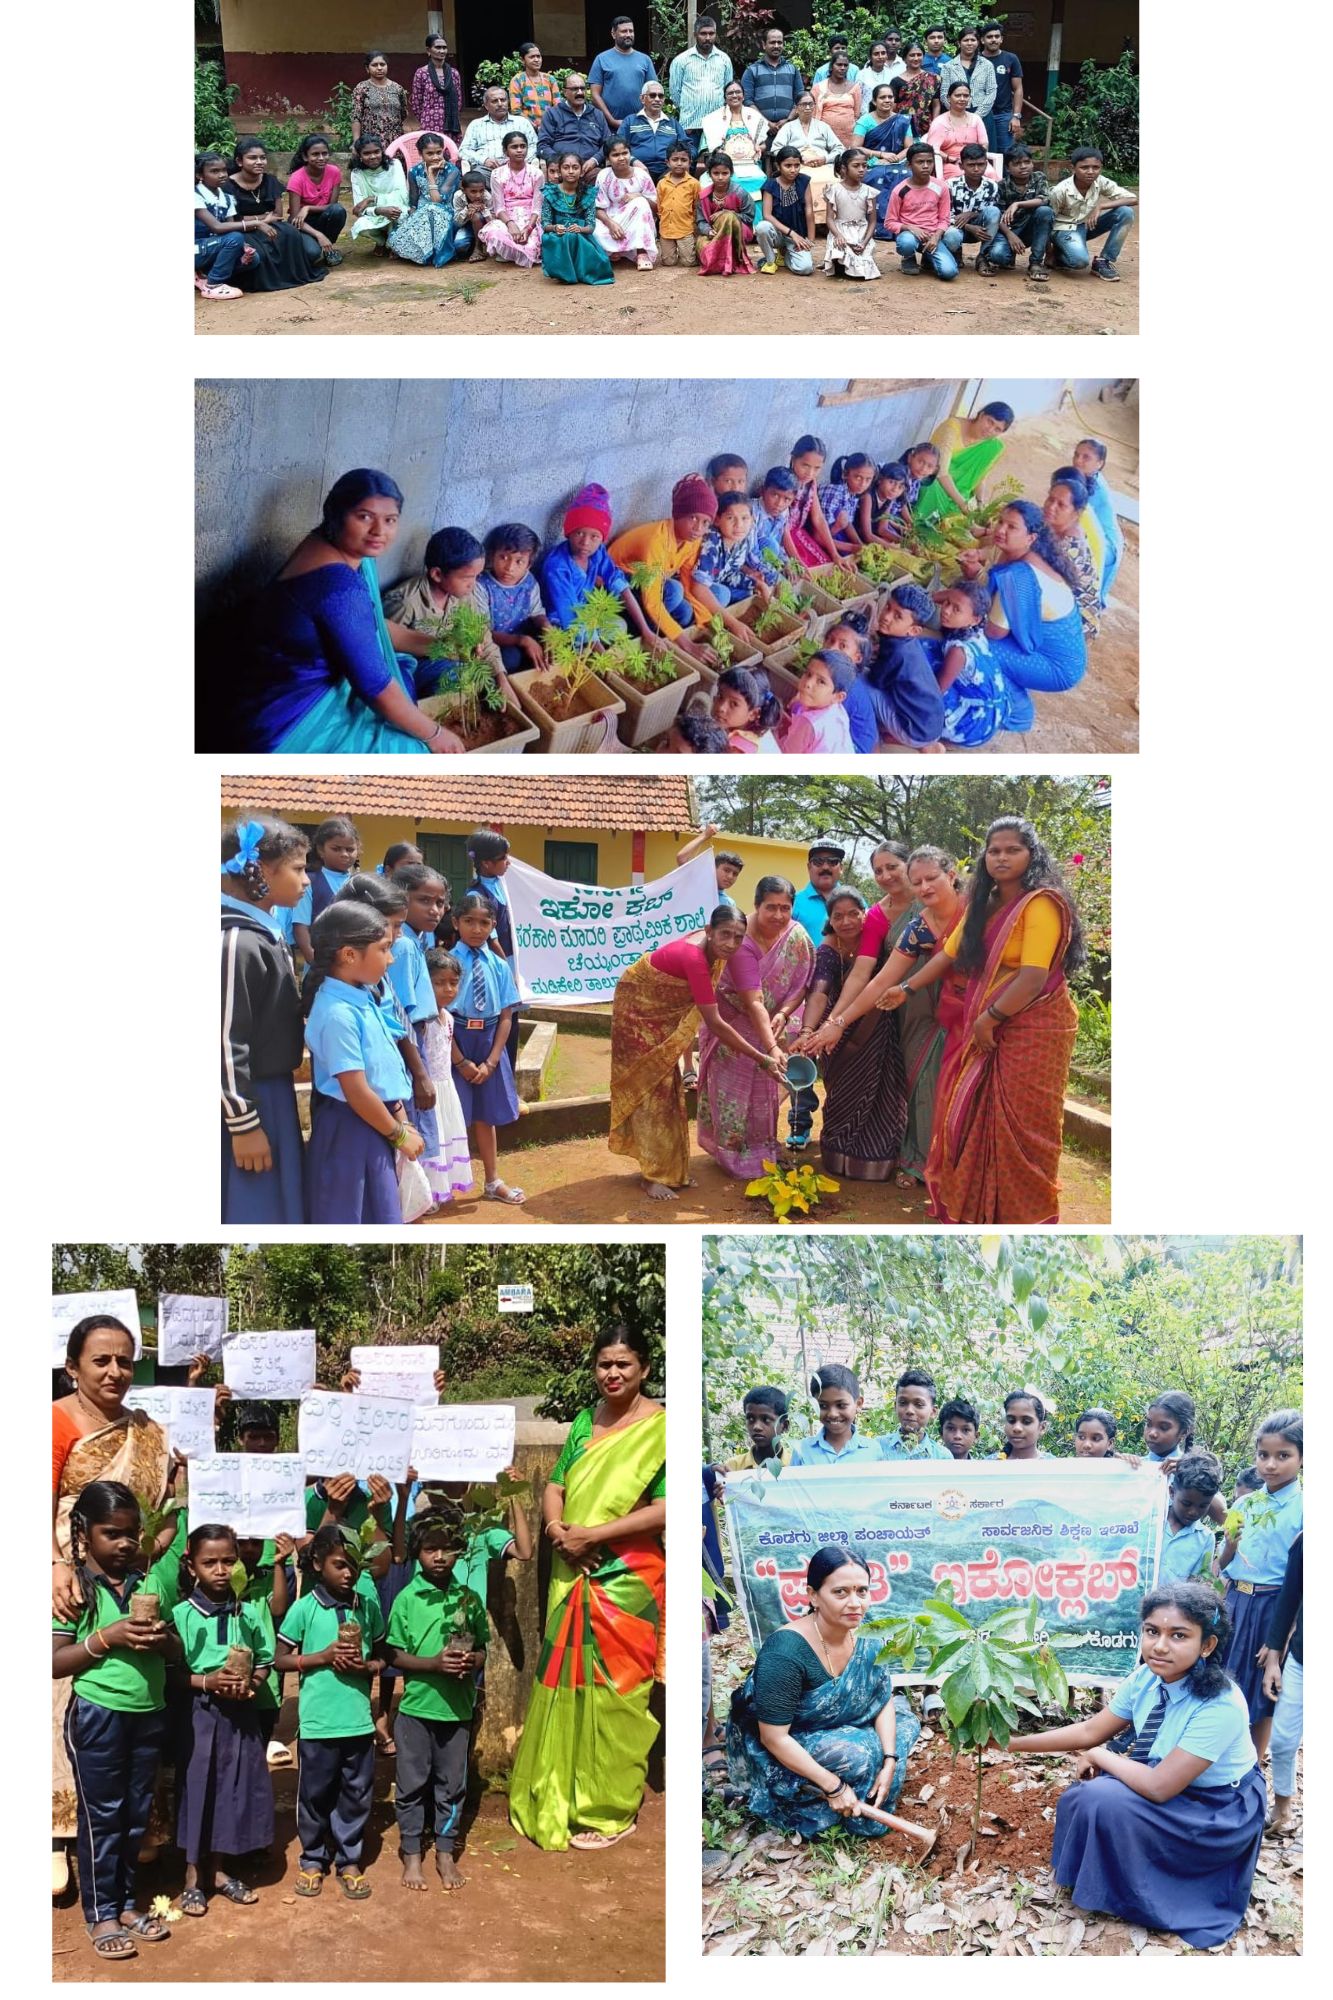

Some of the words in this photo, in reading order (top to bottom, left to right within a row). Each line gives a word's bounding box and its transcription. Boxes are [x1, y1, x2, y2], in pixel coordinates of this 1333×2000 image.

[541, 895, 613, 920] ಇಕೋ
[560, 925, 606, 948] ಮಾದರಿ
[612, 914, 673, 948] ಪ್ರಾಥಮಿಕ
[674, 906, 706, 932] ಶಾಲೆ
[531, 976, 583, 994] ಮಡಿಕೇರಿ
[354, 1405, 409, 1431] ಪರಿಸರ
[889, 1500, 932, 1510] ಕರ್ನಾಟಕ
[969, 1499, 1005, 1509] ಸರ್ಕಾರ
[758, 1530, 812, 1545] ಕೊಡಗು
[817, 1531, 849, 1545] ಜಿಲ್ಲಾ
[854, 1526, 932, 1541] ಪಂಚಾಯತ್
[981, 1523, 1054, 1537] ಸಾರ್ವಜನಿಕ
[1059, 1523, 1092, 1541] ಶಿಕ್ಷಣ
[1099, 1520, 1140, 1537] ಇಲಾಖೆ
